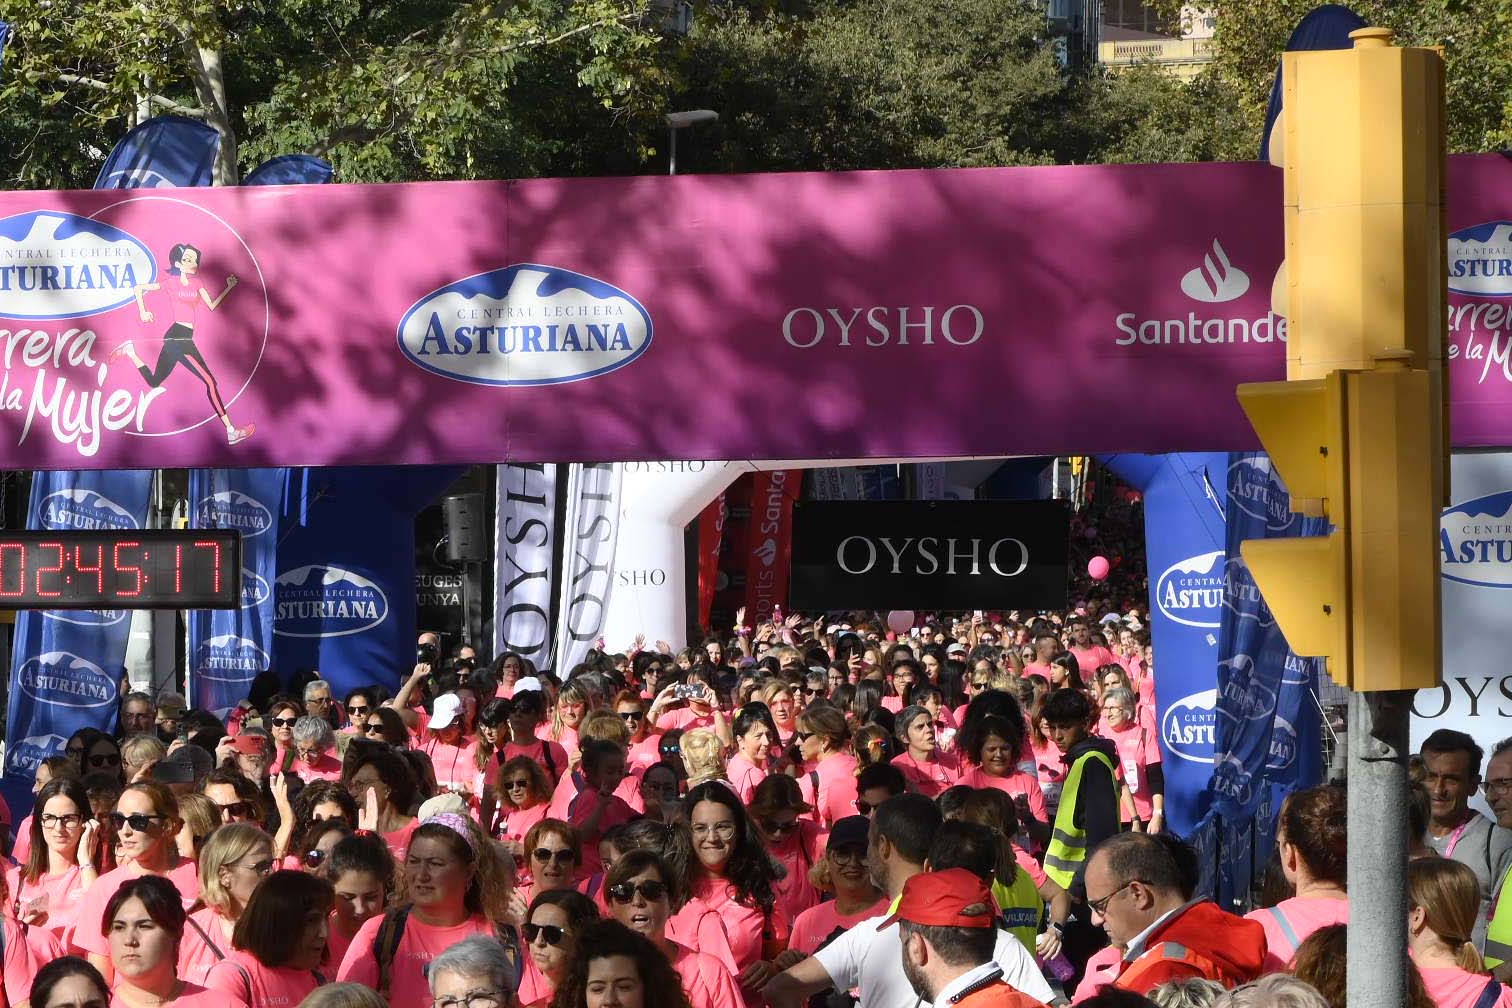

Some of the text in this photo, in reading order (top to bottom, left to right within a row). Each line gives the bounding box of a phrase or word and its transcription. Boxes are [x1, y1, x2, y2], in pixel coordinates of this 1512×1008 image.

[60, 247, 133, 258] LECHERA
[456, 305, 625, 320] CENTRAL LECHERA
[782, 304, 985, 349] OYSHO
[418, 311, 633, 356] ASTURIANA
[1465, 332, 1483, 360] la
[18, 362, 167, 457] Mujer
[43, 502, 128, 530] ASTURIAN
[837, 535, 1029, 577] OYSHO
[614, 568, 666, 587] SHO
[325, 589, 374, 598] LECHERA
[1164, 580, 1224, 608] ASTU
[274, 600, 379, 620] STURIANA
[24, 666, 108, 700] ASTURIANA
